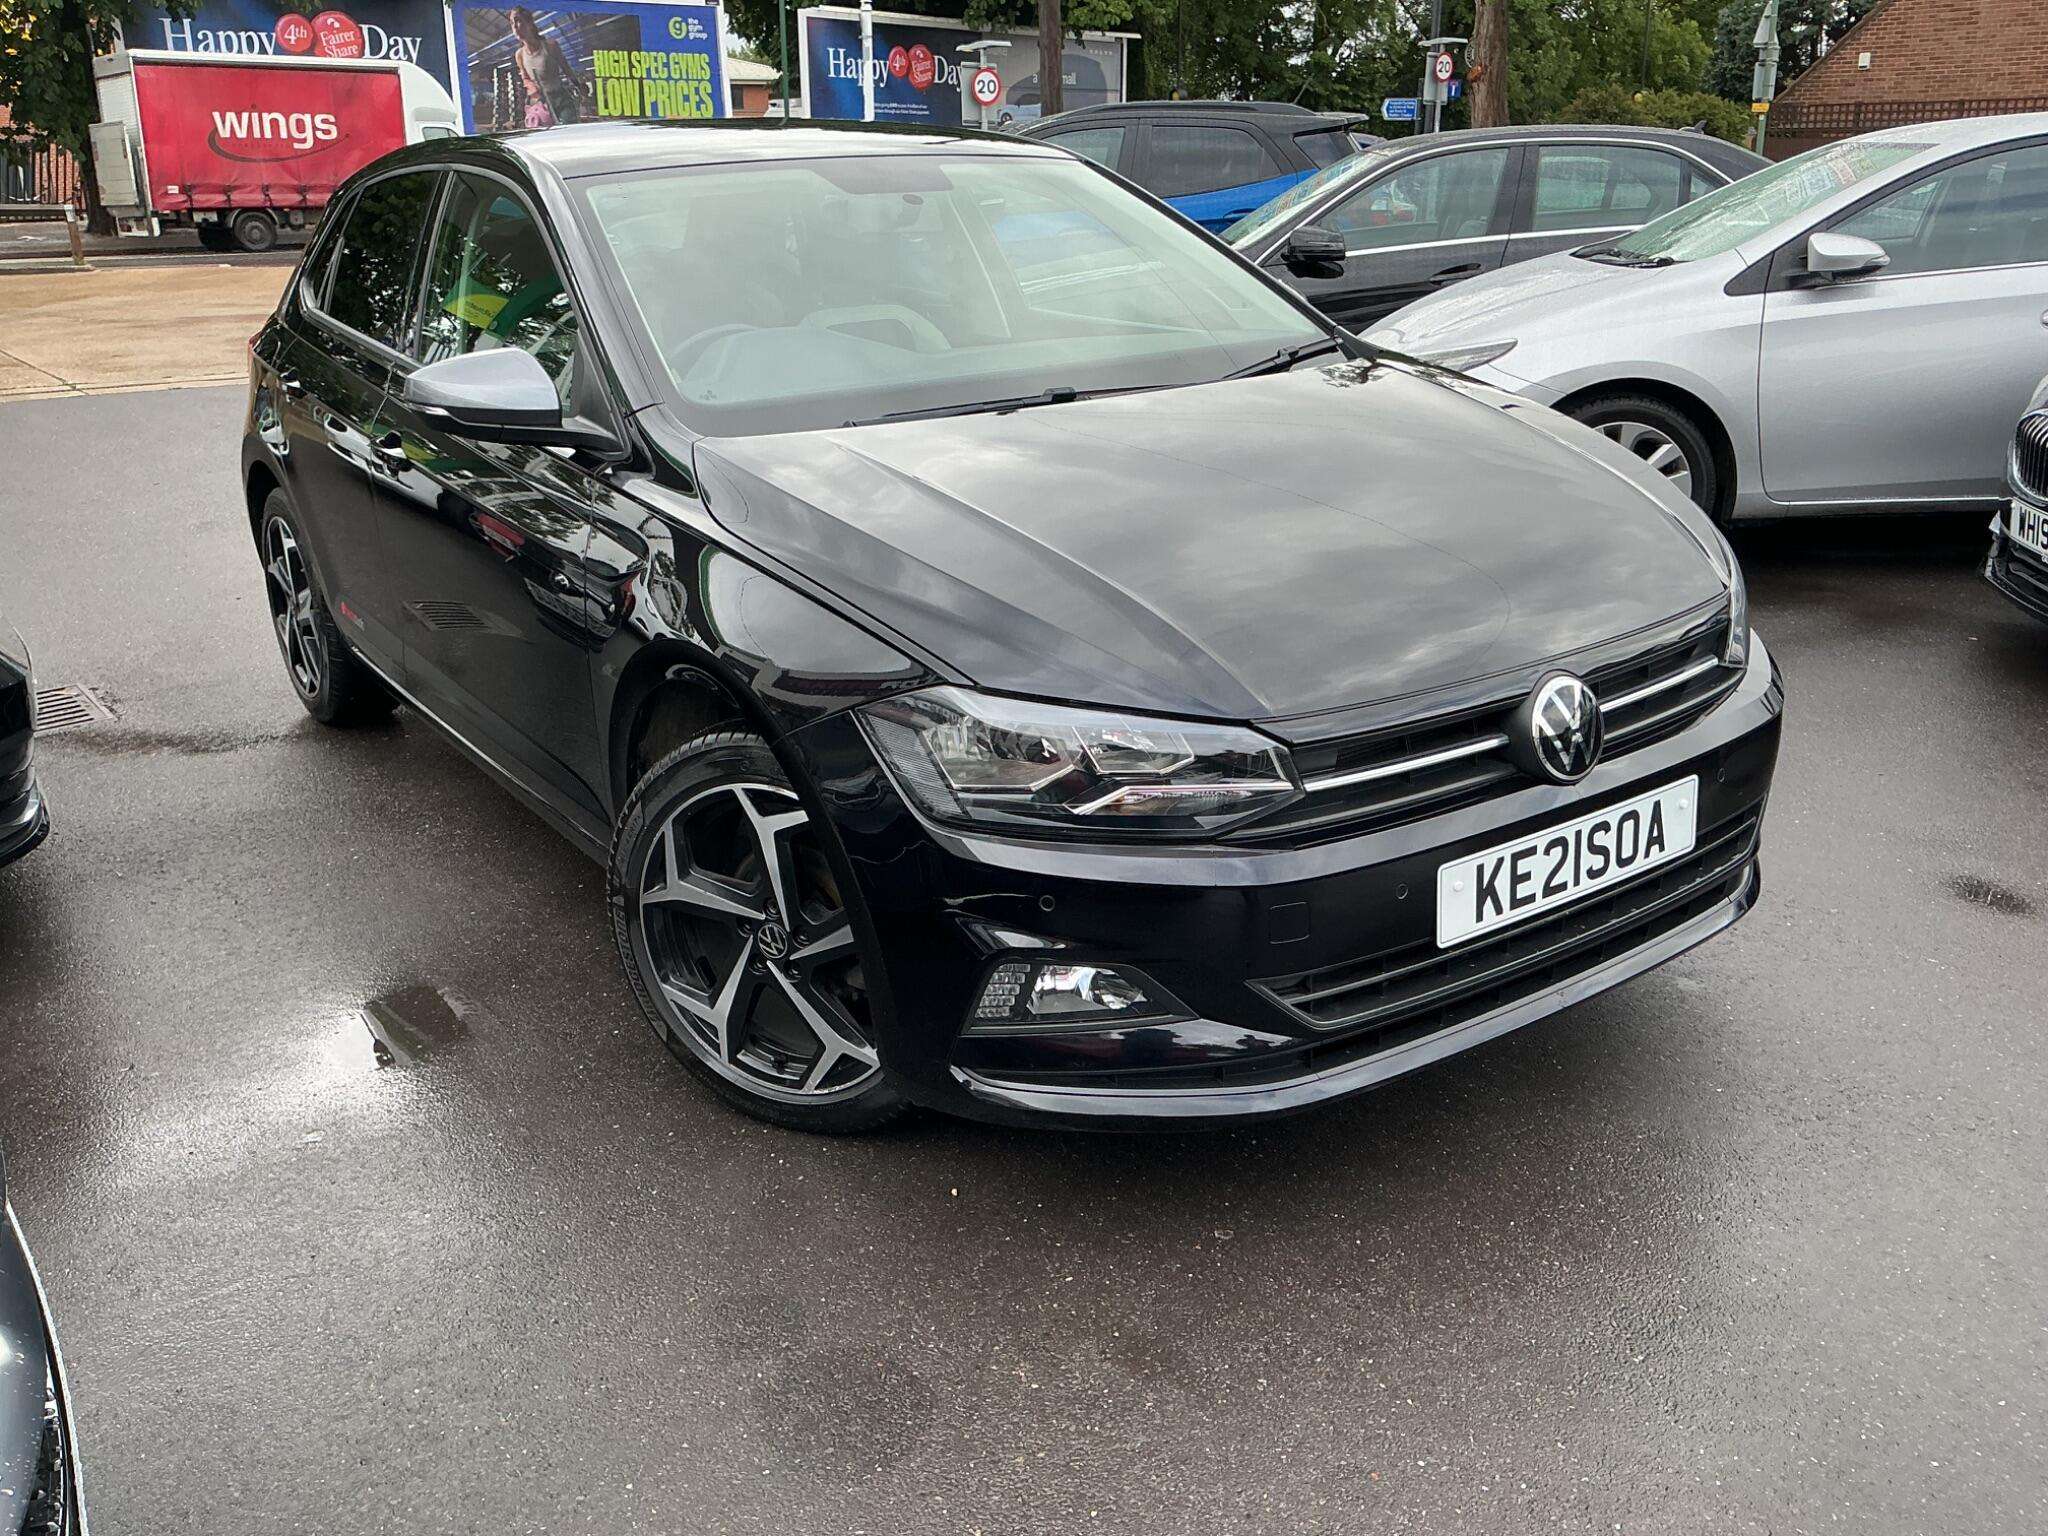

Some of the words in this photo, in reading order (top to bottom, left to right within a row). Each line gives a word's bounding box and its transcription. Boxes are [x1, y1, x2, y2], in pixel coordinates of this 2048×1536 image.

[158, 17, 276, 55] Happy
[284, 23, 307, 45] 4th
[358, 23, 422, 64] Day
[320, 30, 355, 47] Fairer
[324, 44, 359, 59] Share
[593, 50, 630, 77] HIGH
[631, 51, 668, 79] SPEC
[669, 52, 711, 80] GYMS
[1438, 61, 1451, 73] 20
[595, 78, 640, 117] LOW
[643, 80, 714, 119] PRICES
[976, 79, 997, 94] 20
[211, 111, 338, 150] wings
[1475, 799, 1666, 924] KE21SOA
